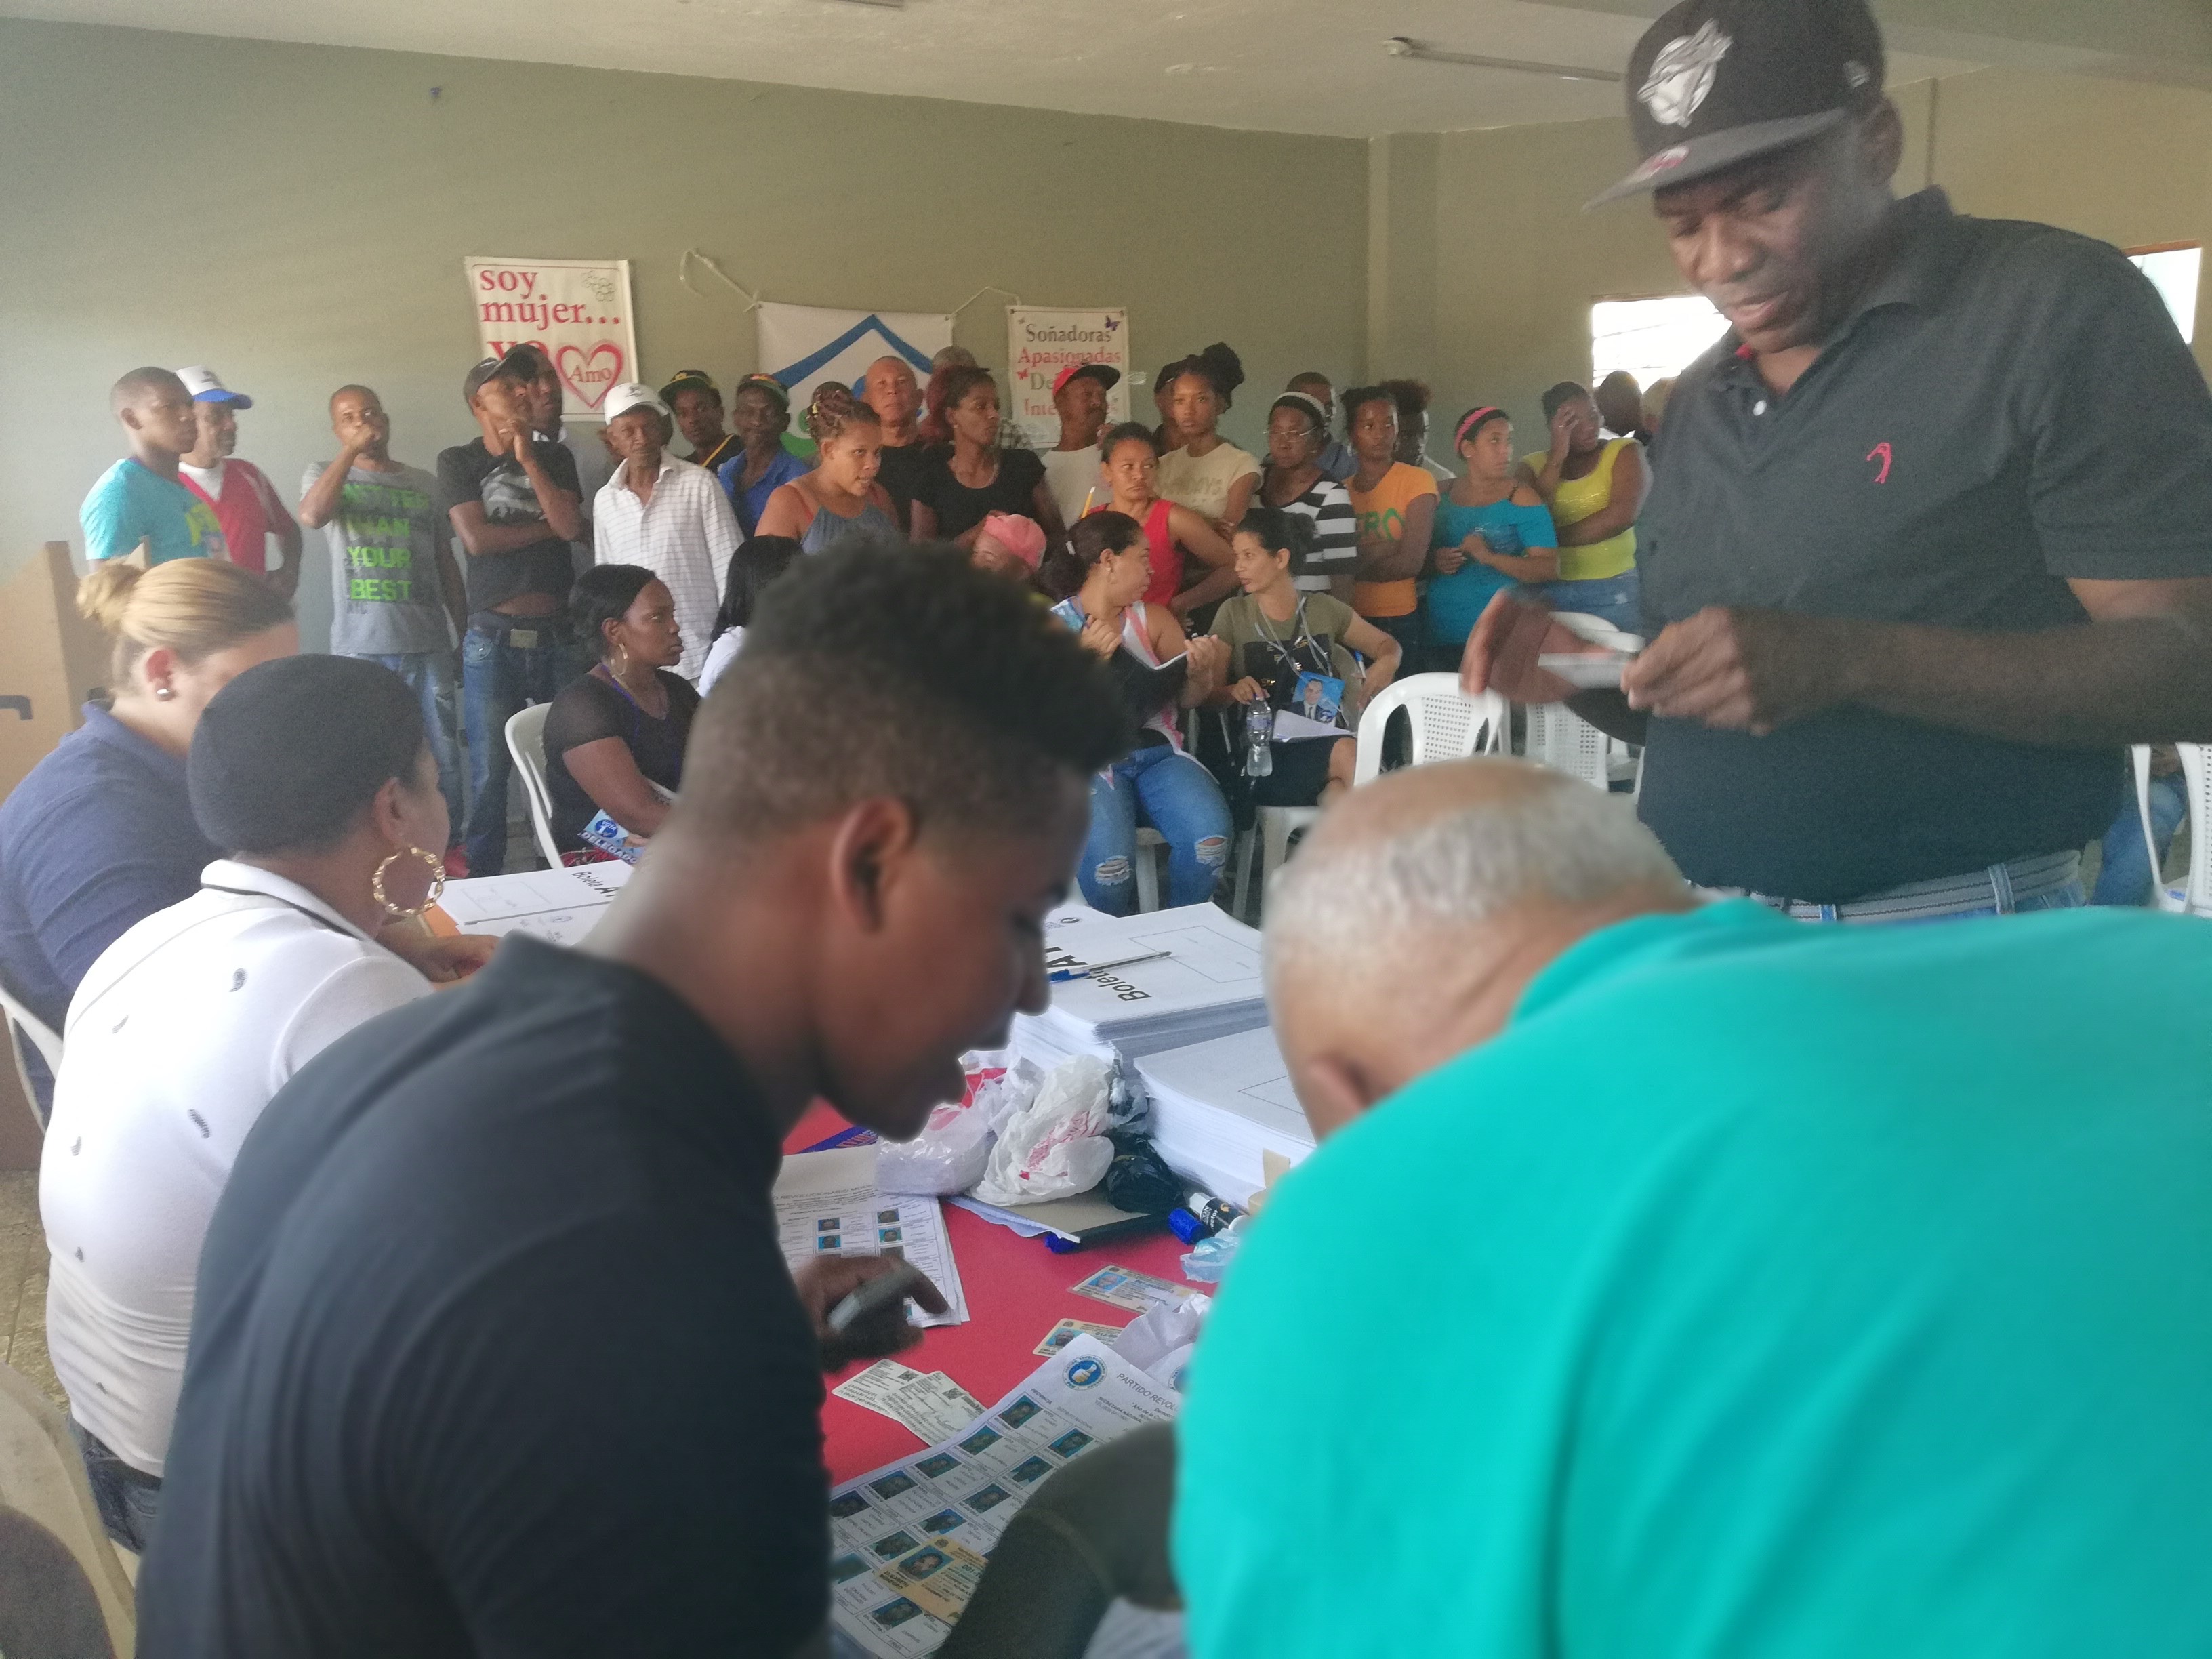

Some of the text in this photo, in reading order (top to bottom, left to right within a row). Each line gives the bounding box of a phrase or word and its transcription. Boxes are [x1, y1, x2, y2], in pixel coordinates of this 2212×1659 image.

[480, 270, 537, 299] soy
[481, 294, 620, 331] mujer...
[1025, 323, 1112, 342] Soñadoras
[1018, 346, 1121, 367] Apasionadas
[568, 366, 611, 383] Amo
[347, 546, 412, 569] YOUR
[350, 579, 412, 600] BEST
[1117, 1373, 1151, 1397] PARTIDO
